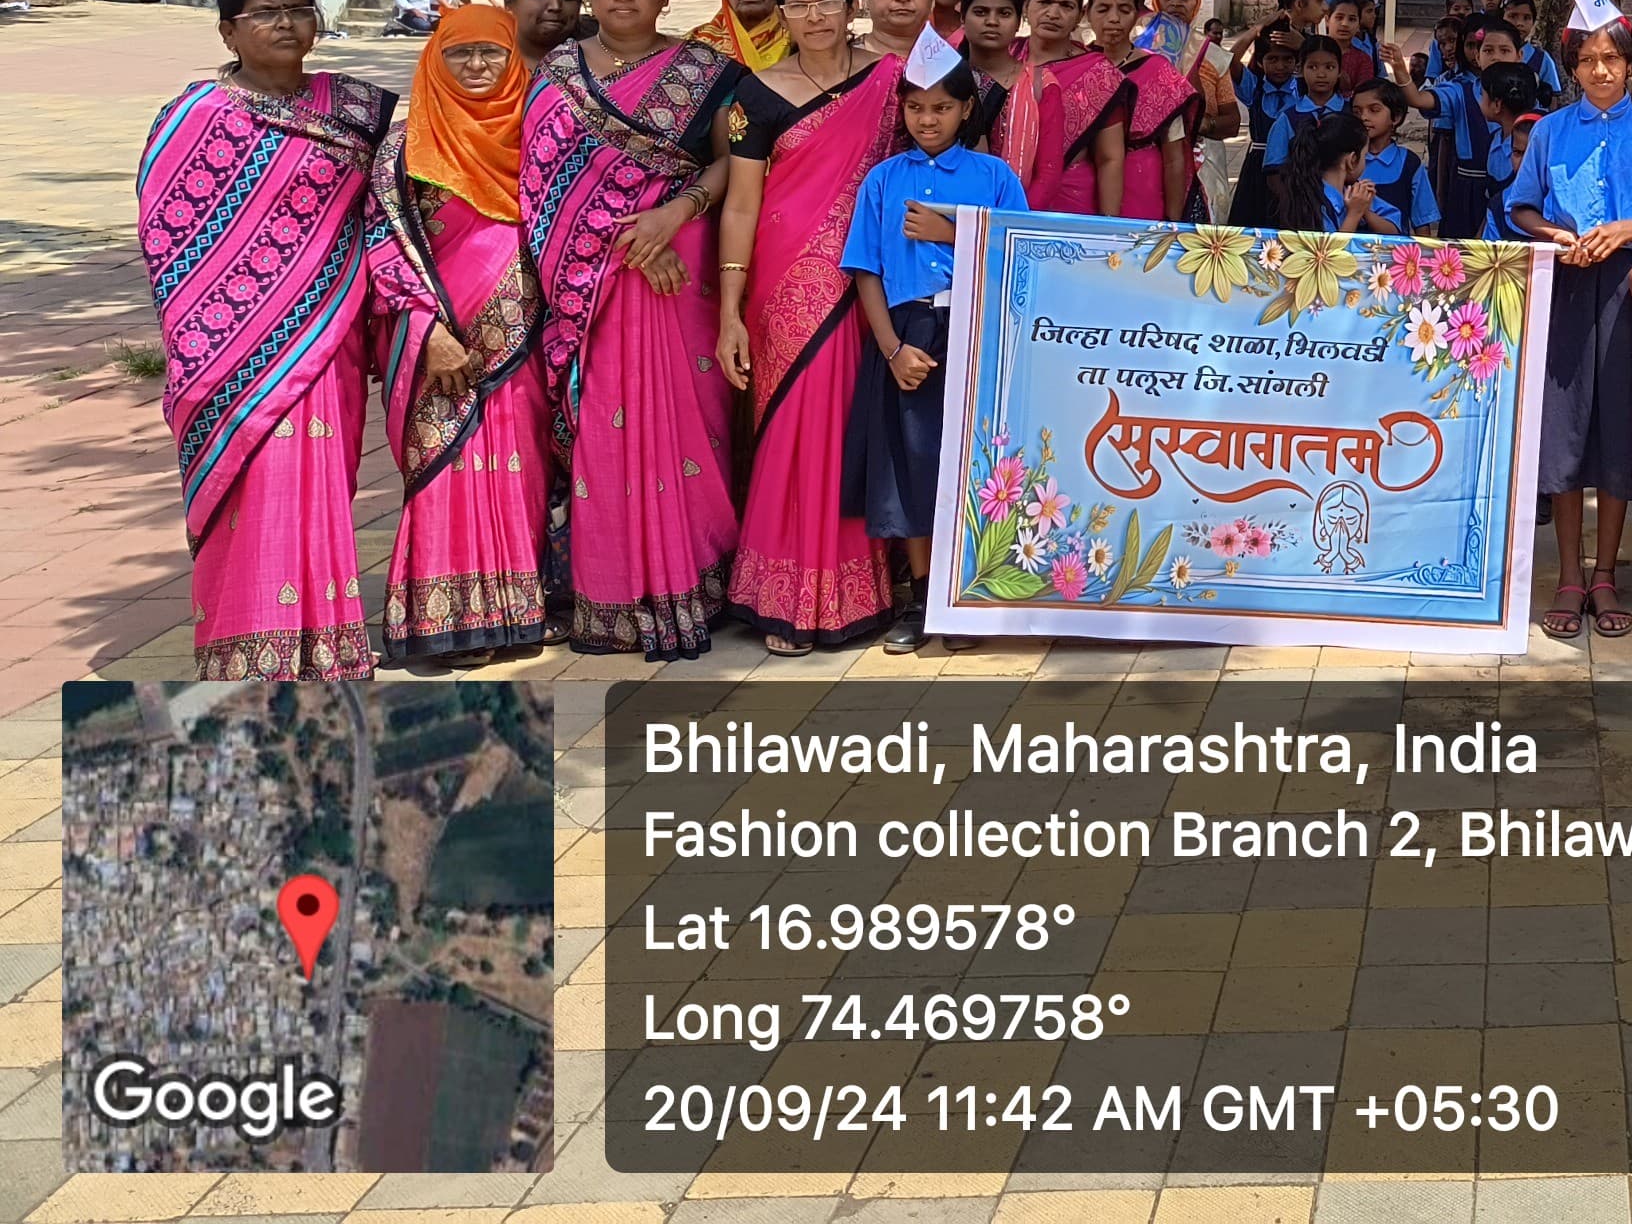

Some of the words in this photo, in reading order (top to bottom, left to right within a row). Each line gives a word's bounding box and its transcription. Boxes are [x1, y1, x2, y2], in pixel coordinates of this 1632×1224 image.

[1031, 317, 1110, 350] जिल्हा
[1119, 322, 1203, 356] परिषद
[1077, 366, 1110, 386] ता
[1115, 368, 1186, 398] पलूस
